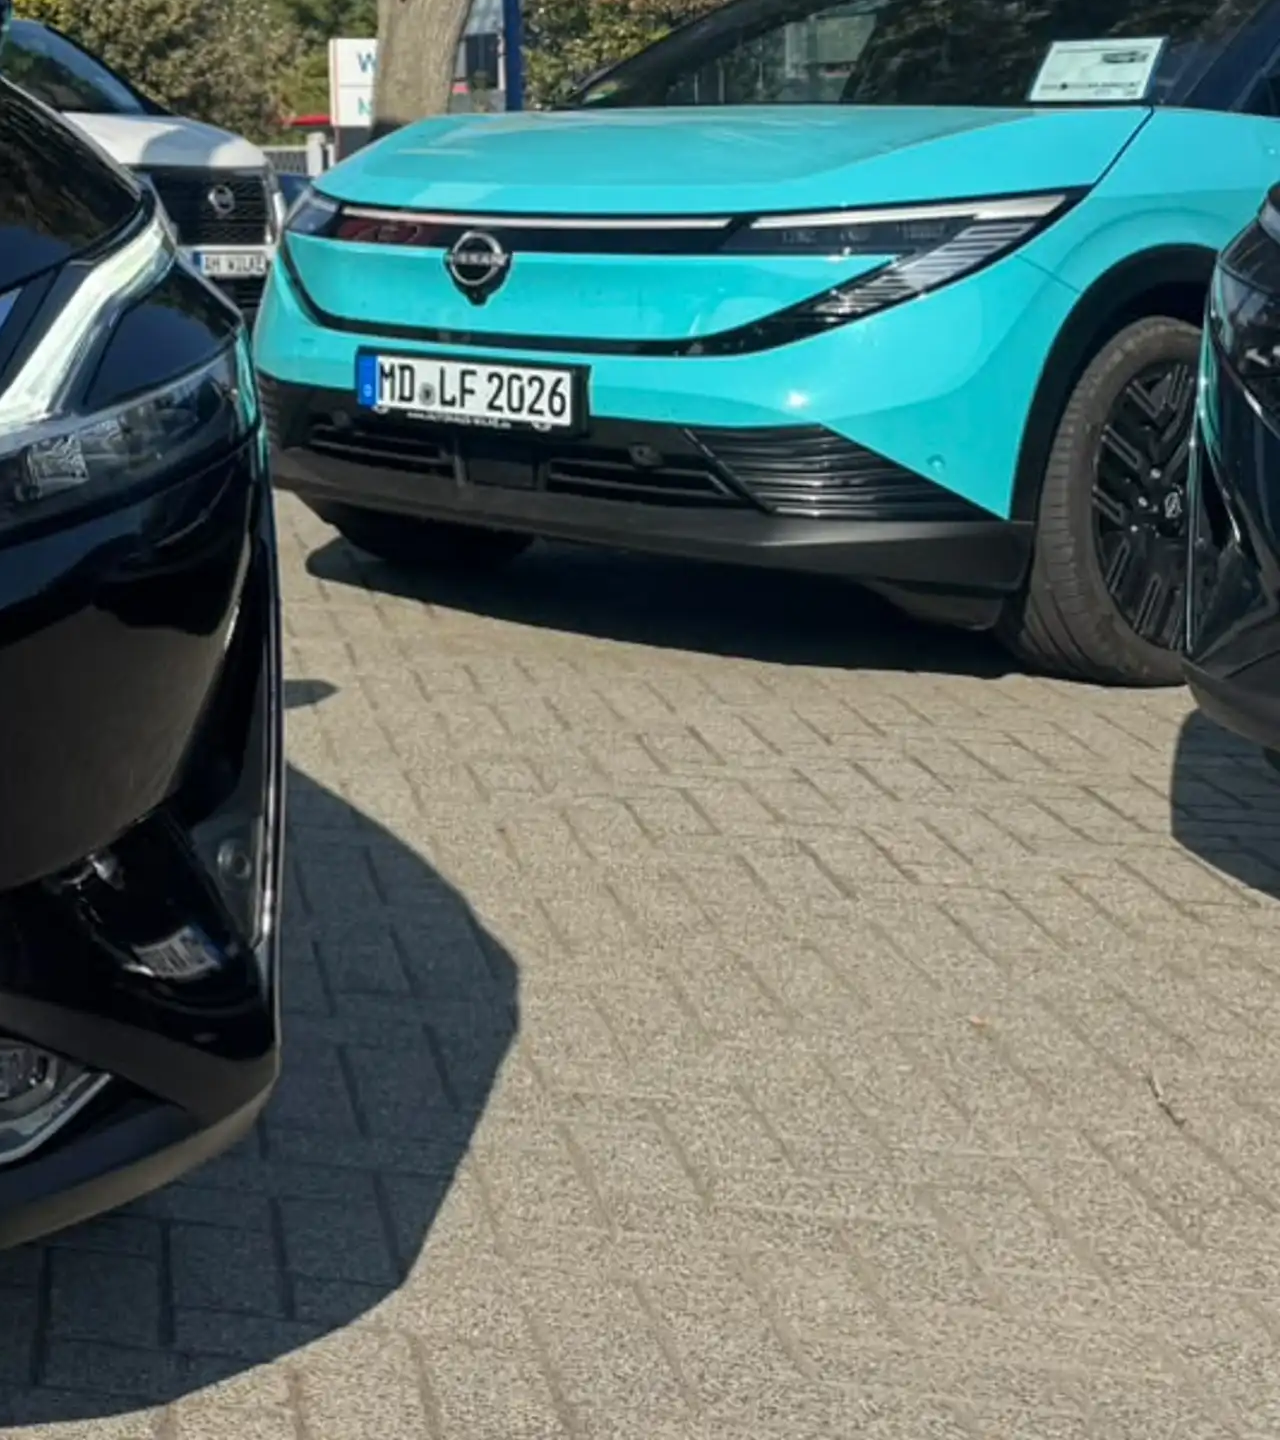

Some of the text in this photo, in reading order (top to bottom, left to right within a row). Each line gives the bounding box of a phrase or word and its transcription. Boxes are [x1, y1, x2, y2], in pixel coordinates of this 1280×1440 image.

[379, 363, 567, 417] MD LF 2026
